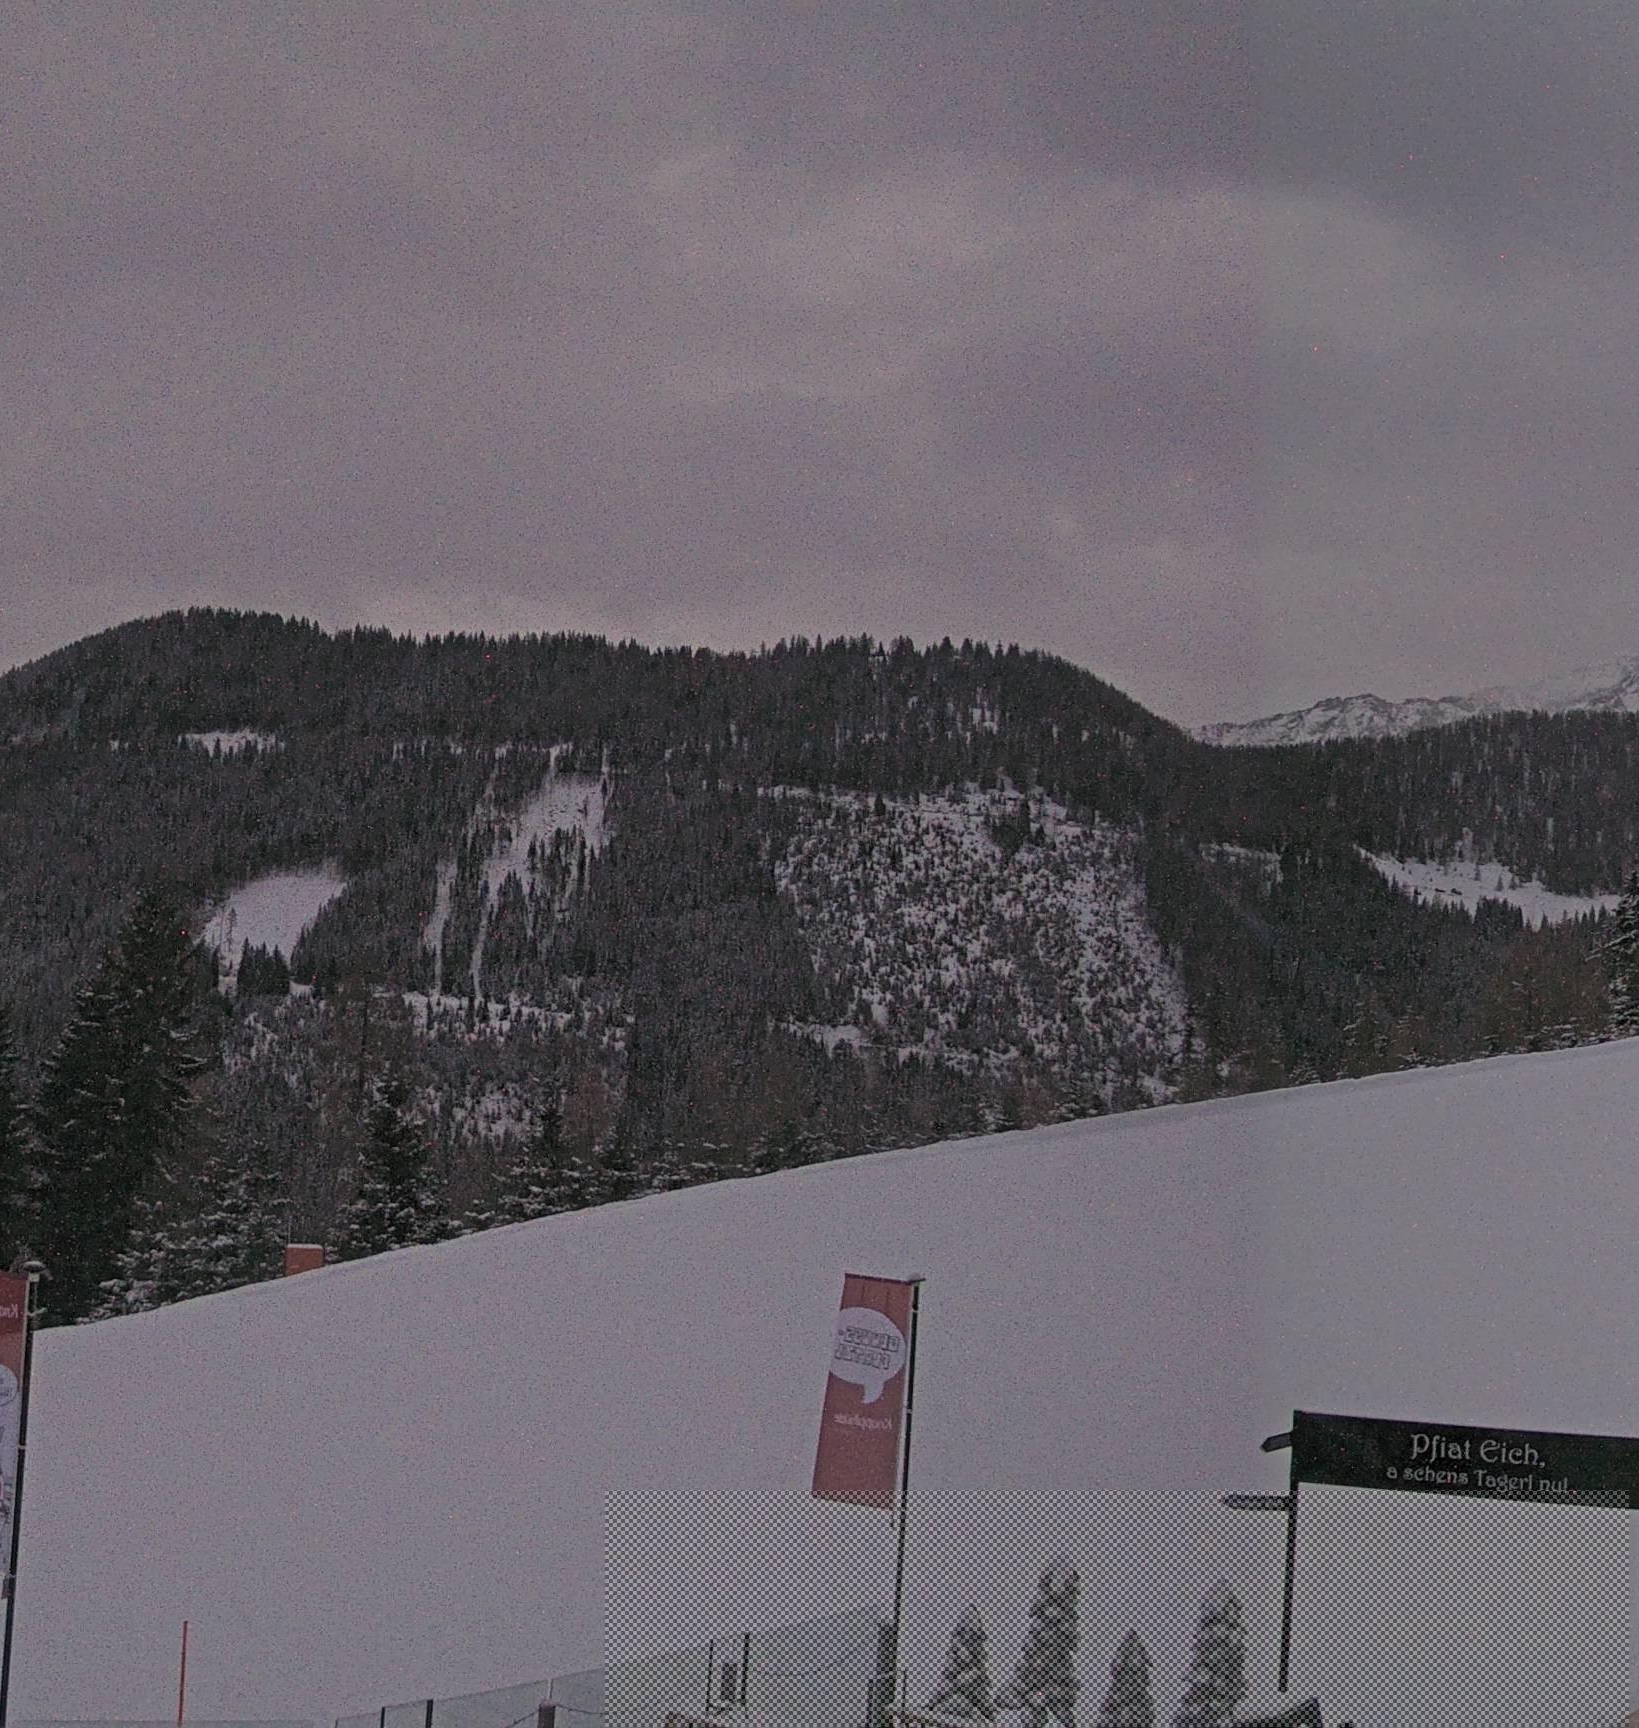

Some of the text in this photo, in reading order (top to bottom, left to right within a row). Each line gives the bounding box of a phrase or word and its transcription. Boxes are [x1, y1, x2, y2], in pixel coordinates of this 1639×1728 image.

[1411, 1433, 1546, 1468] Pfiat Eich,
[1386, 1466, 1398, 1480] a
[1403, 1466, 1469, 1484] schens
[1474, 1469, 1533, 1492] Tagerl
